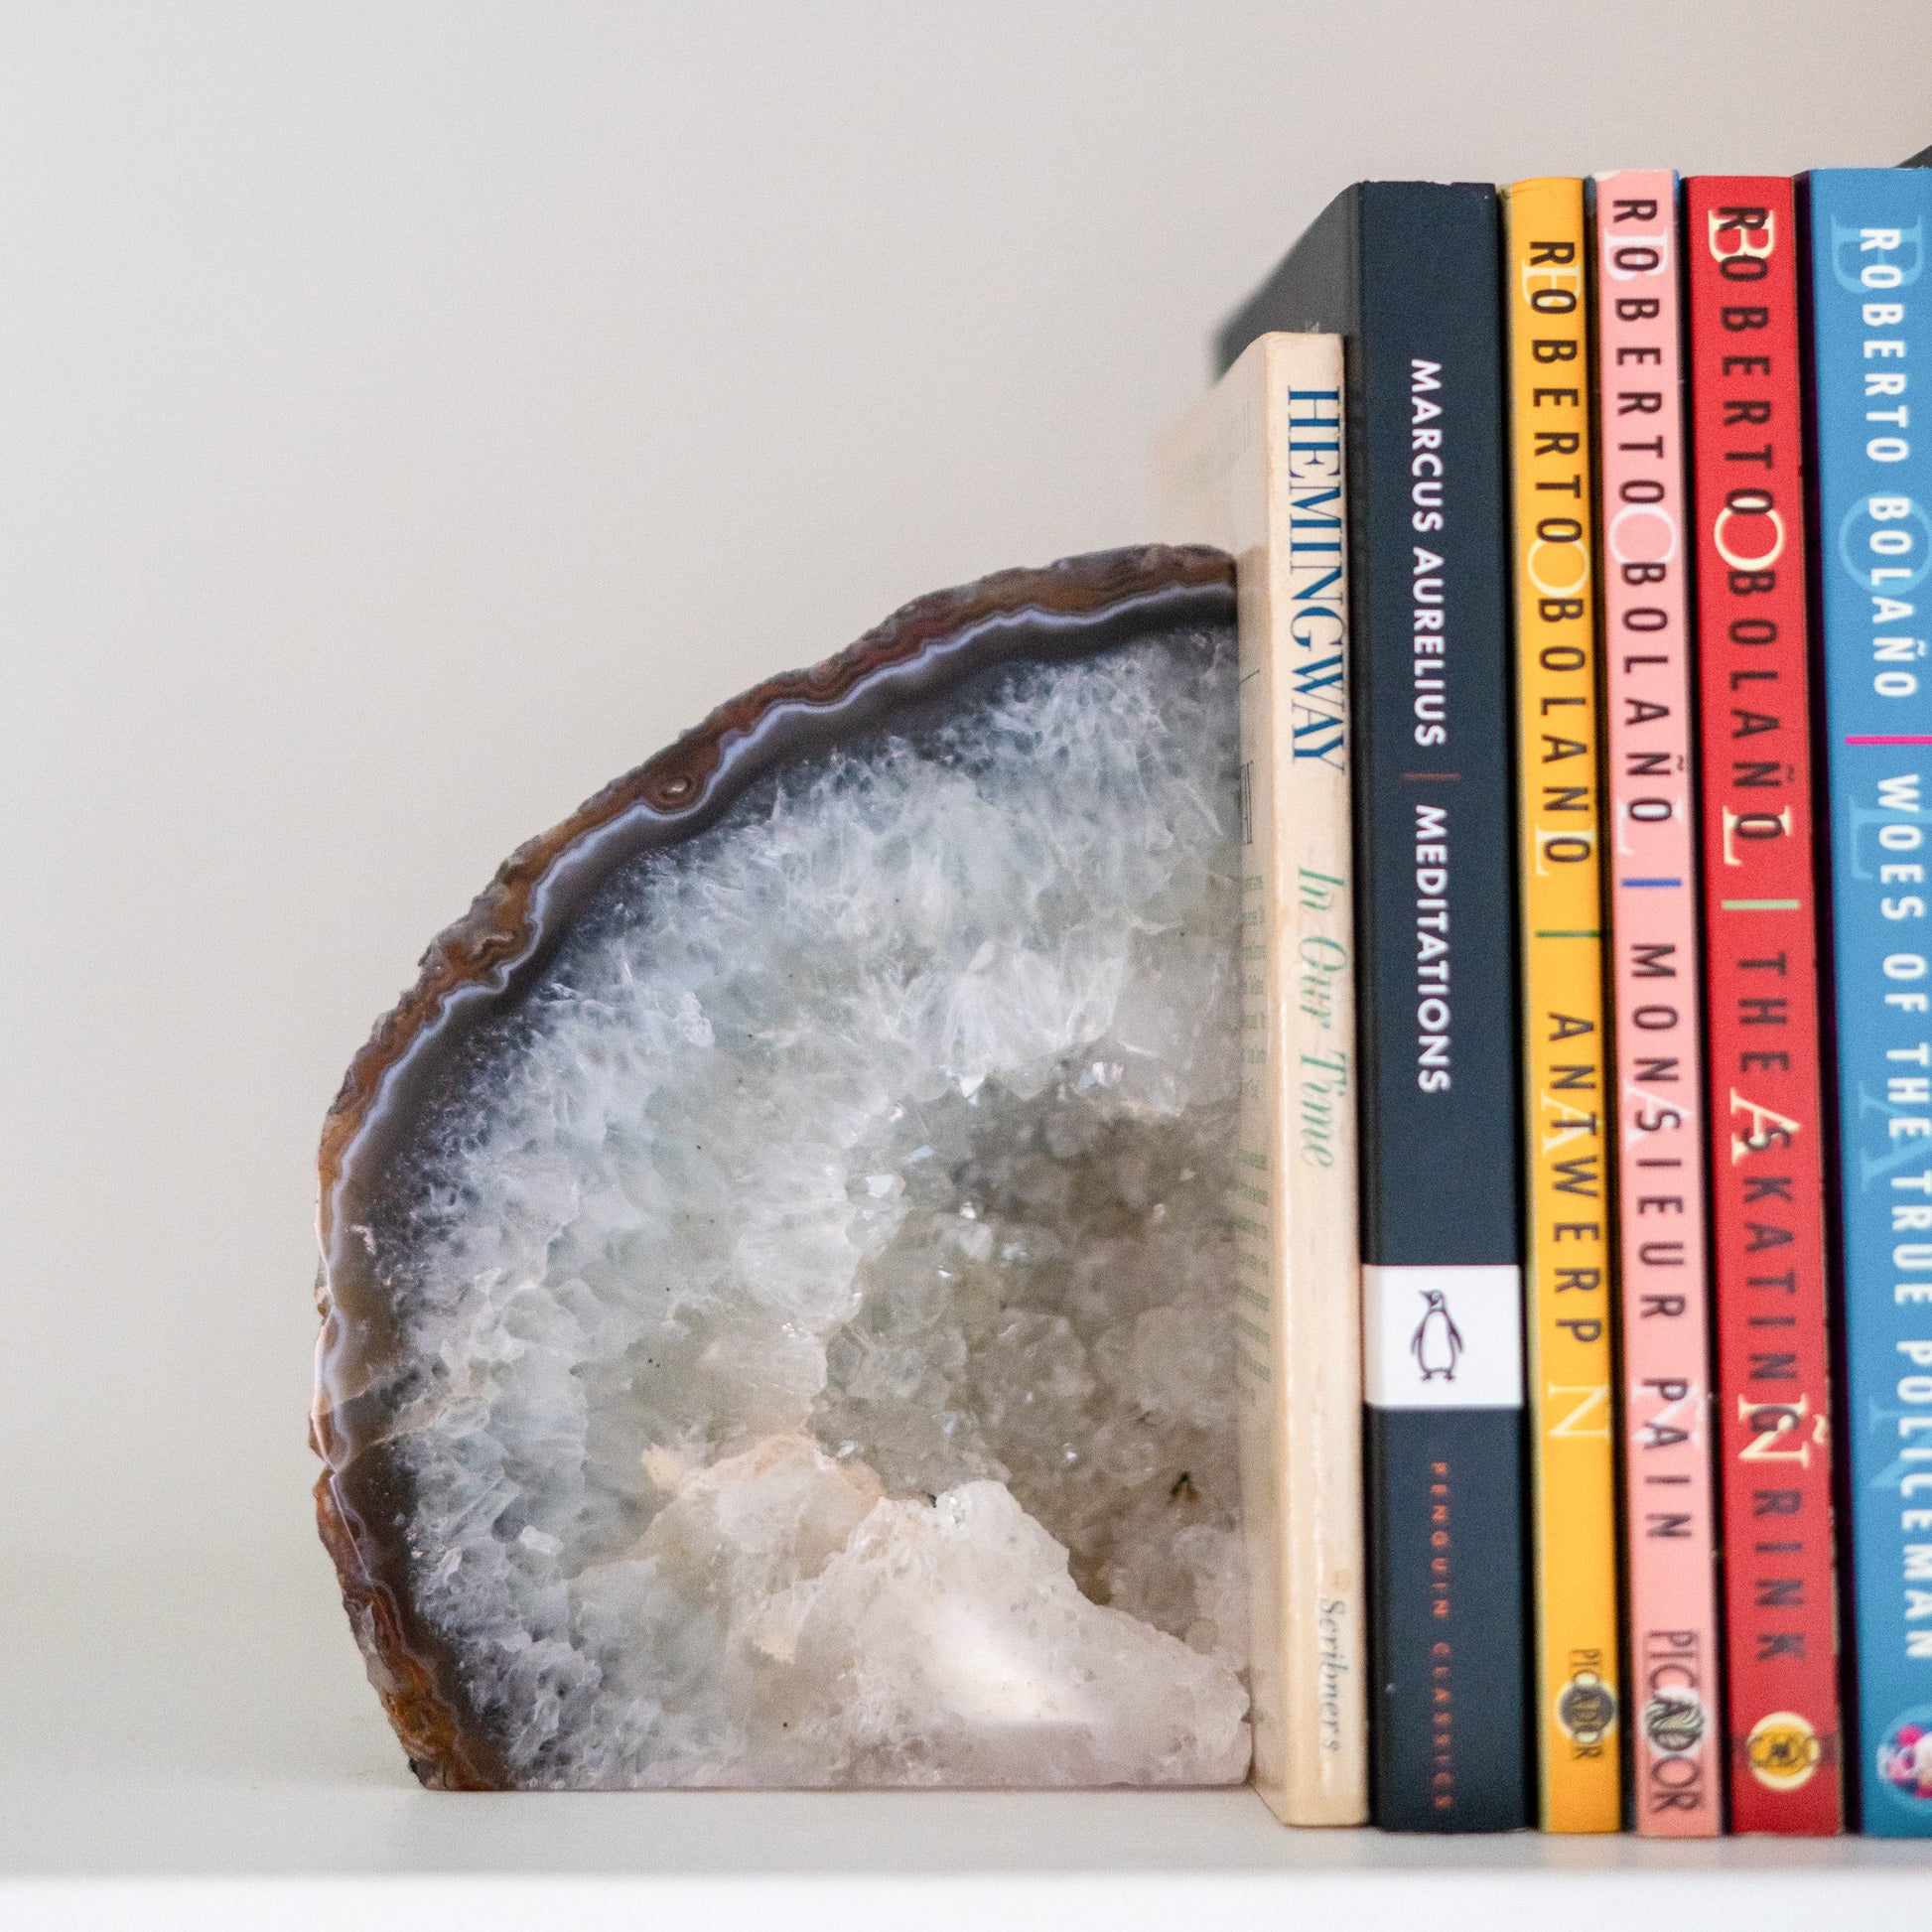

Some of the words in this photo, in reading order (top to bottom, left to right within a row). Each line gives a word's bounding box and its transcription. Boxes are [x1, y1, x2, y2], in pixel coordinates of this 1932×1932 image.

[1528, 241, 1583, 543] ROBERTO
[1612, 199, 1664, 503] ROBERTO
[1719, 207, 1774, 516] ROBERTO
[1860, 228, 1910, 462] ROBERTO
[1411, 358, 1444, 534] MARCUS
[1287, 386, 1346, 774] HEMINGWAY
[1413, 546, 1447, 749] AURELIUS
[1867, 495, 1930, 698] BOLAÑO
[1622, 562, 1685, 823] BOLAÑO
[1727, 570, 1796, 841] BOLAÑO
[1298, 867, 1345, 912] In
[1878, 773, 1923, 921] WOES
[1298, 935, 1347, 1030] Our
[1415, 805, 1450, 1094] MEDITATIONS
[1738, 952, 1789, 1073] THE
[1882, 952, 1928, 1013] OF
[1300, 1048, 1349, 1169] Time
[1548, 1012, 1602, 1345] ANTWERP
[1631, 944, 1688, 1319] MONSIEUR
[1883, 1042, 1932, 1141] THE
[1741, 1128, 1800, 1434] SKATING
[1890, 1170, 1932, 1306] TRUE
[1431, 1461, 1449, 1620] PENGUIN
[1642, 1378, 1692, 1541] PAIN
[1897, 1340, 1932, 1659] POLICEMAN
[1753, 1490, 1806, 1662] RINK
[1431, 1643, 1453, 1811] CLASSICS
[1645, 1630, 1706, 1815] PICADOR
